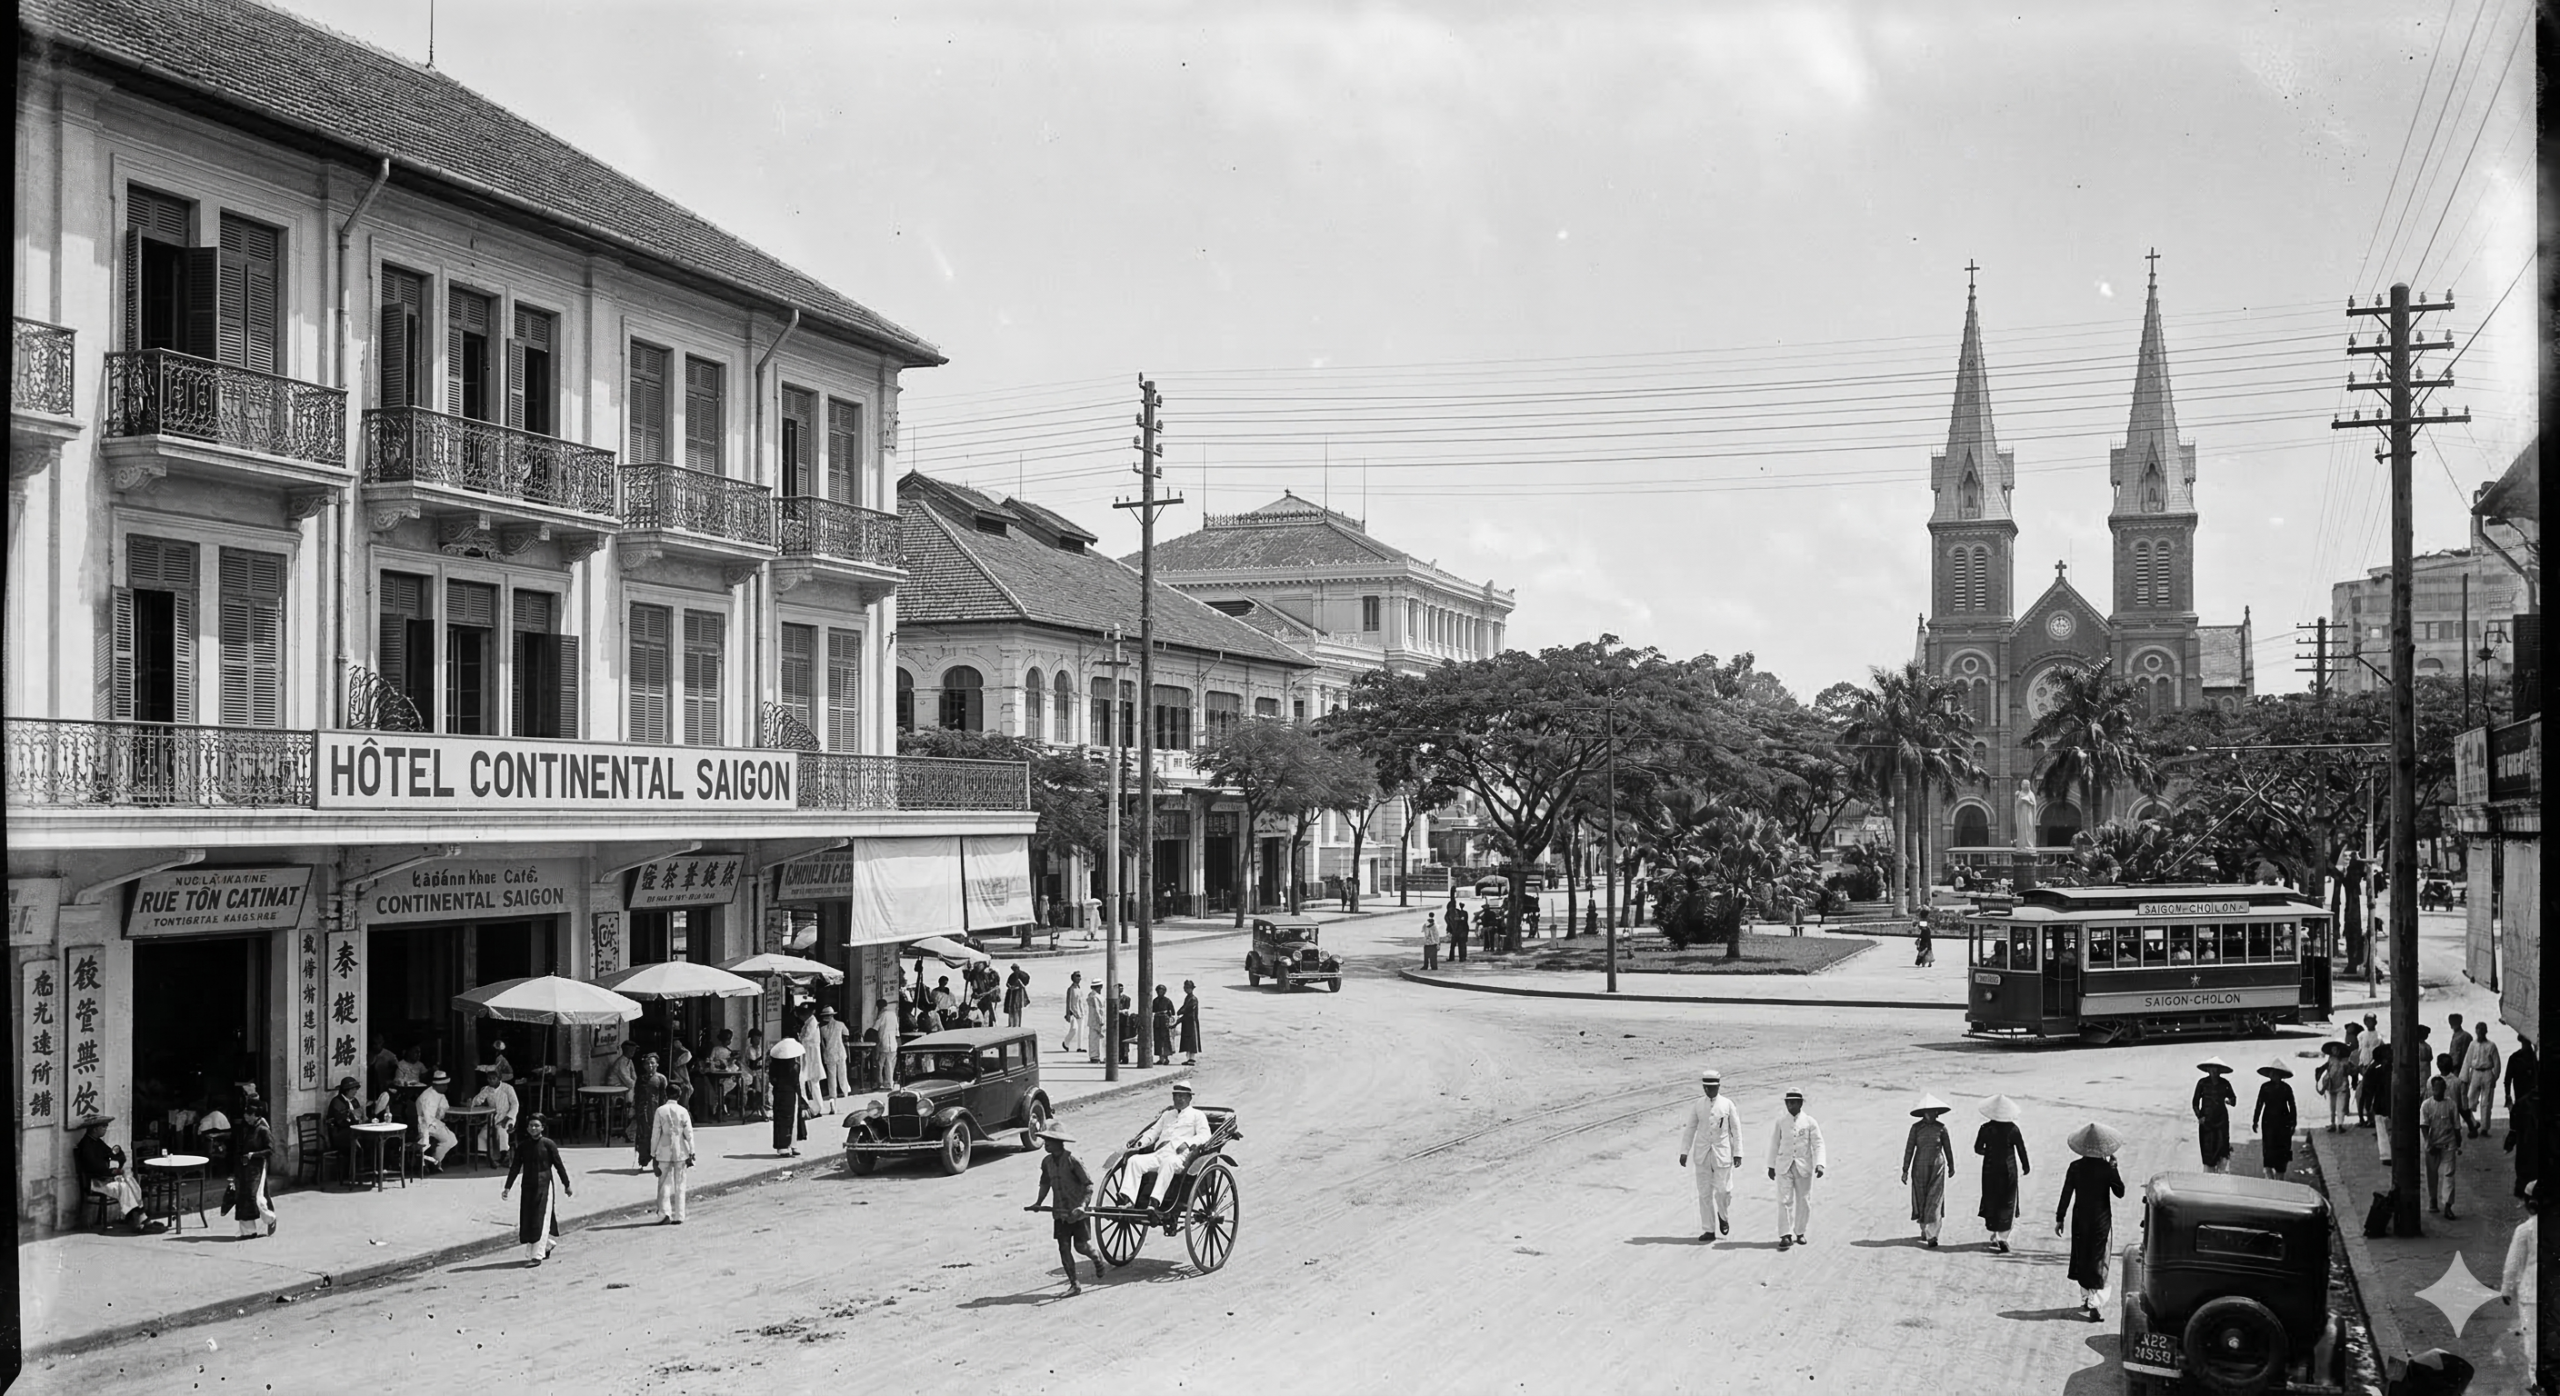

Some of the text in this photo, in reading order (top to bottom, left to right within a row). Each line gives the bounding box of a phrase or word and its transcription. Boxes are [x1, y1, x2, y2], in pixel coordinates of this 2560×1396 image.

[330, 736, 791, 801] HÔTEL CONTINENTAL SAIGON
[139, 886, 300, 914] RUE TÔN CATINAT
[376, 888, 564, 915] CONTINENTAL SAIGON
